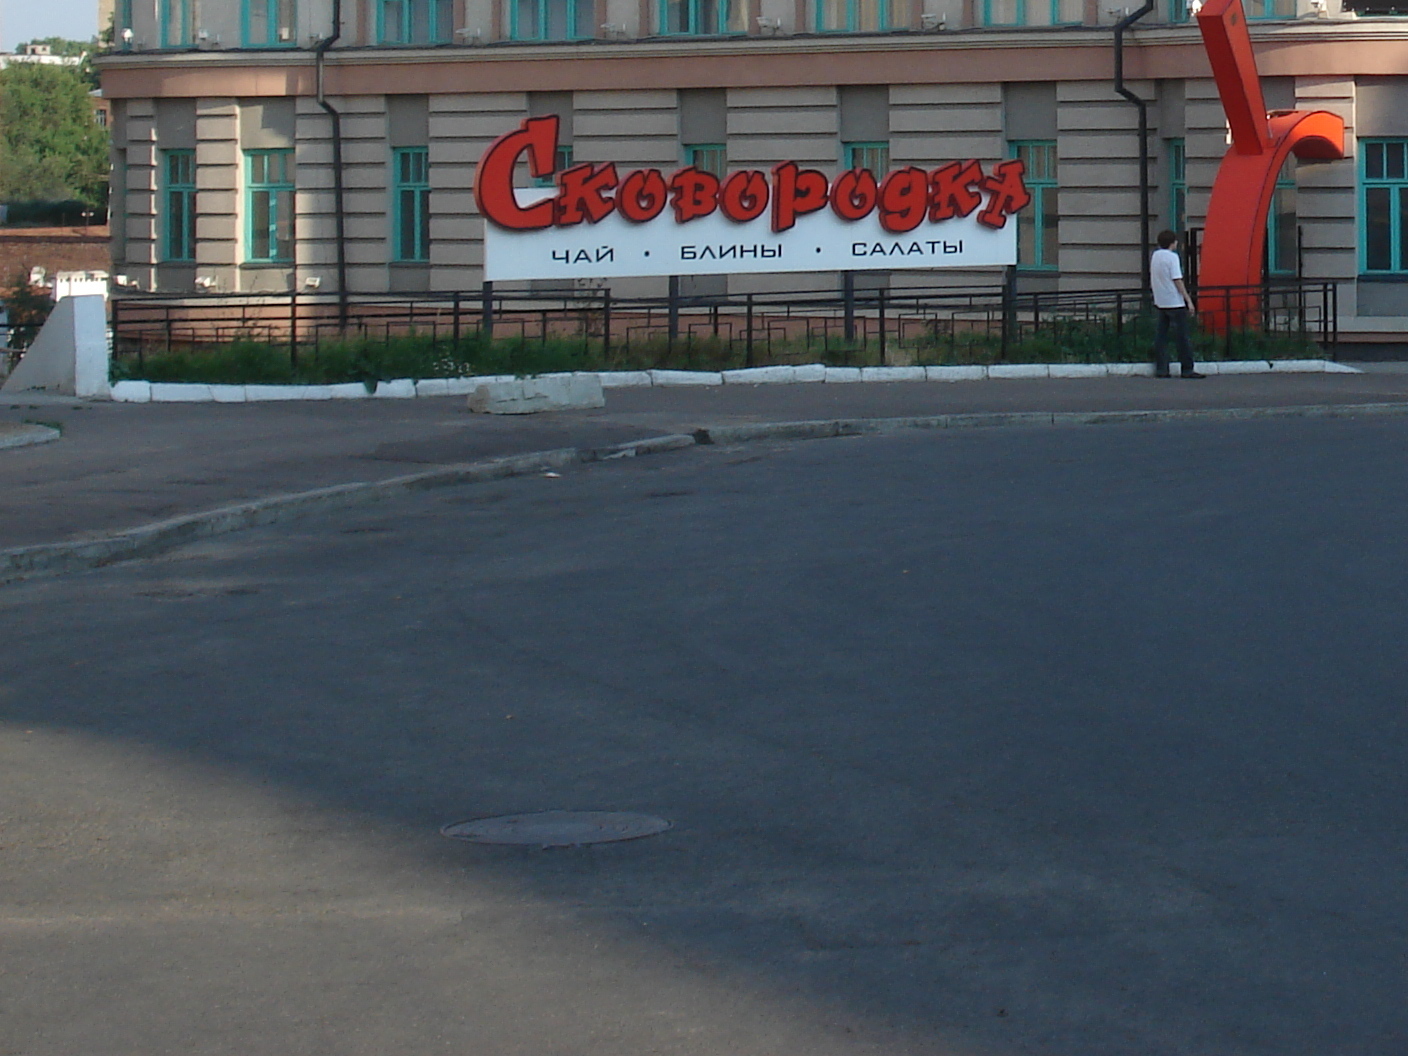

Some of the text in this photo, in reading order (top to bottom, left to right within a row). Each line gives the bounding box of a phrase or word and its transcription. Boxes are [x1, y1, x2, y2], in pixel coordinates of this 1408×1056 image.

[551, 240, 964, 264] ЧАЙ БЛИНЫ САЛАТЫ
